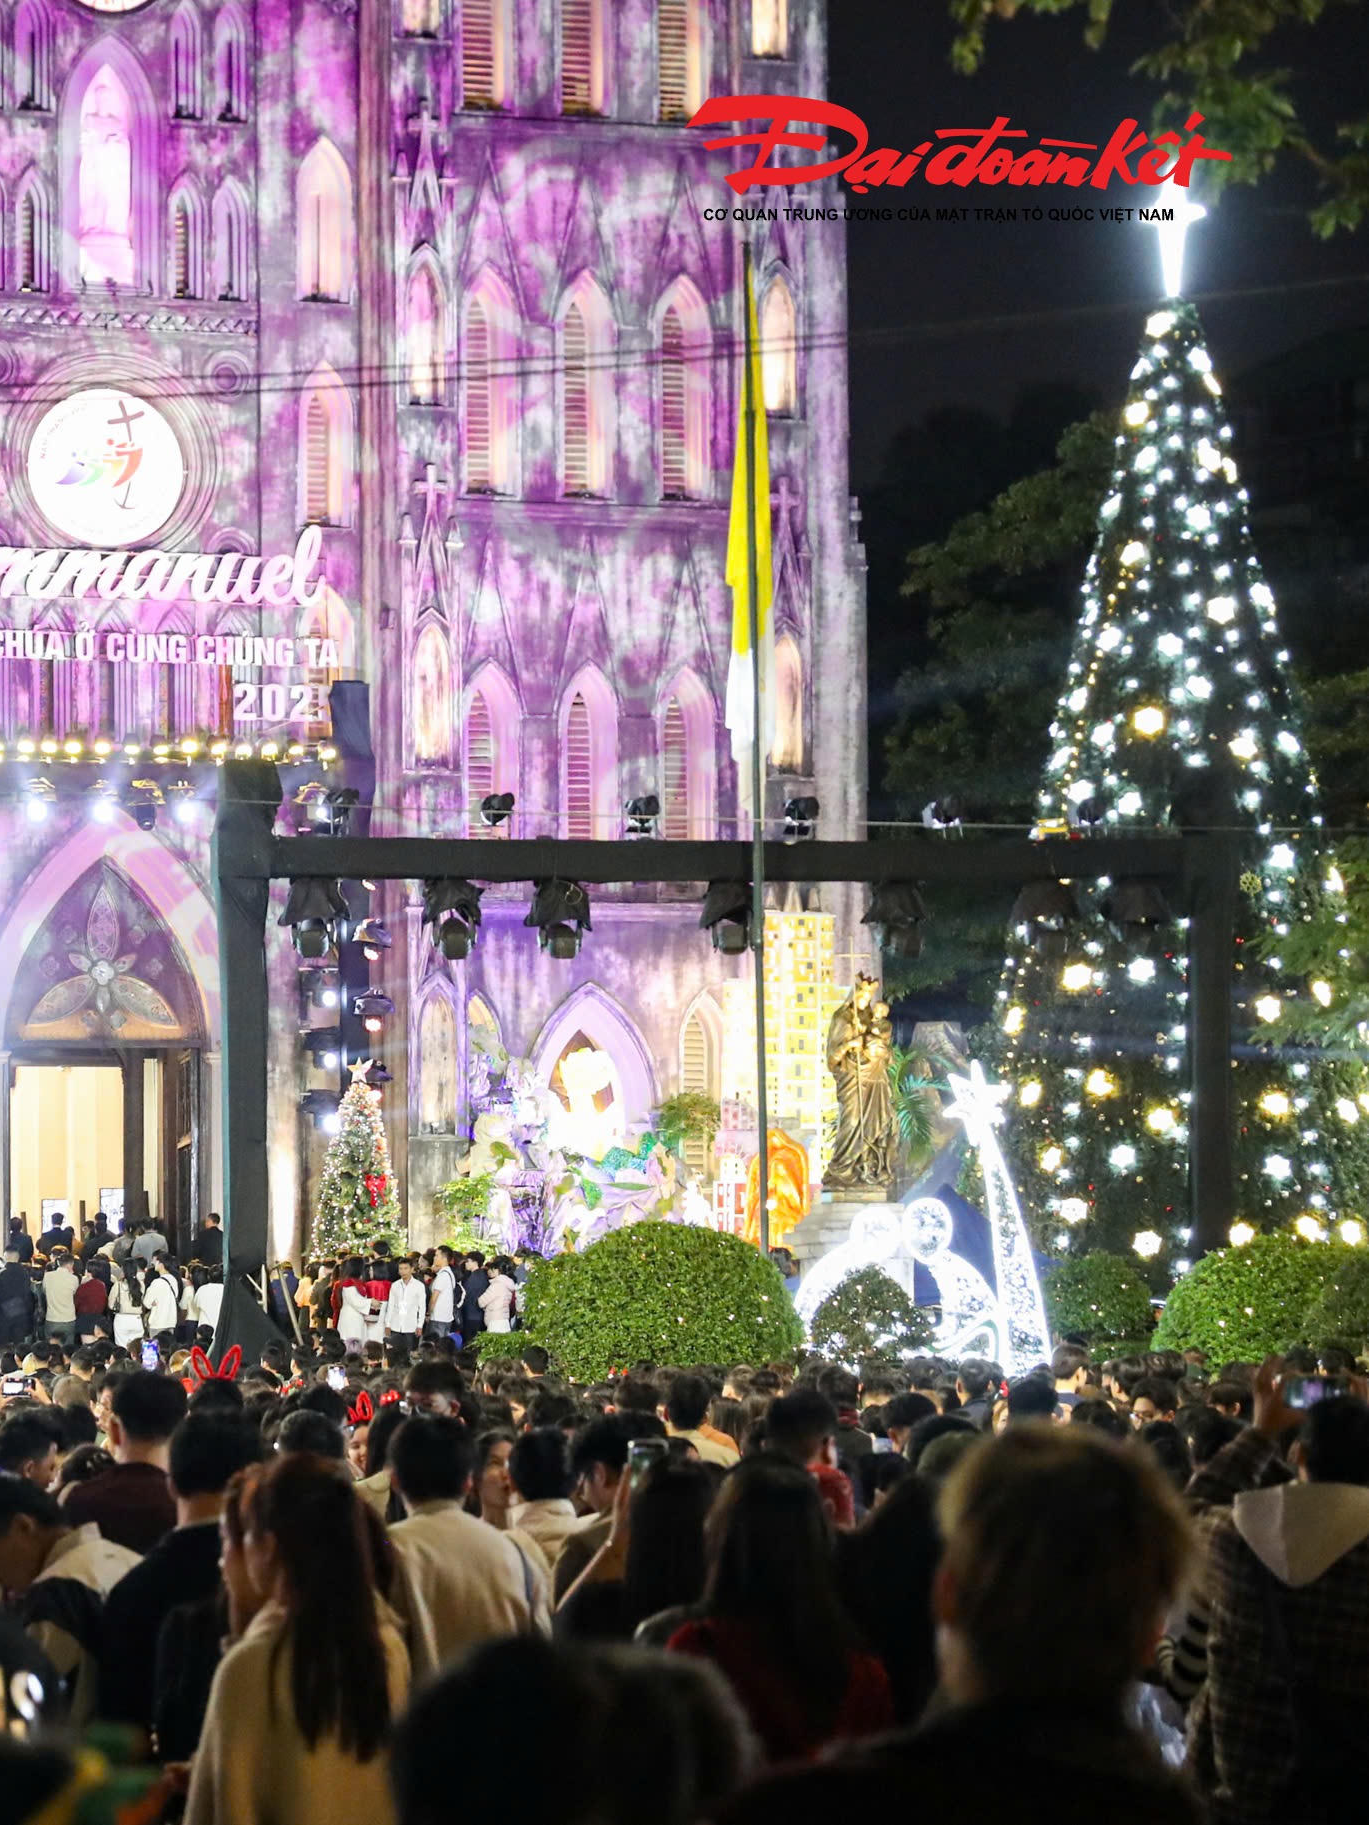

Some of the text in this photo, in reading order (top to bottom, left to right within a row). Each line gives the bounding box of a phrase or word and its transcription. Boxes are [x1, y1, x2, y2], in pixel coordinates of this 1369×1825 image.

[74, 621, 96, 661] Ở
[105, 628, 188, 664] CÙNG
[195, 630, 295, 667] CHÚNG
[304, 637, 339, 668] TA
